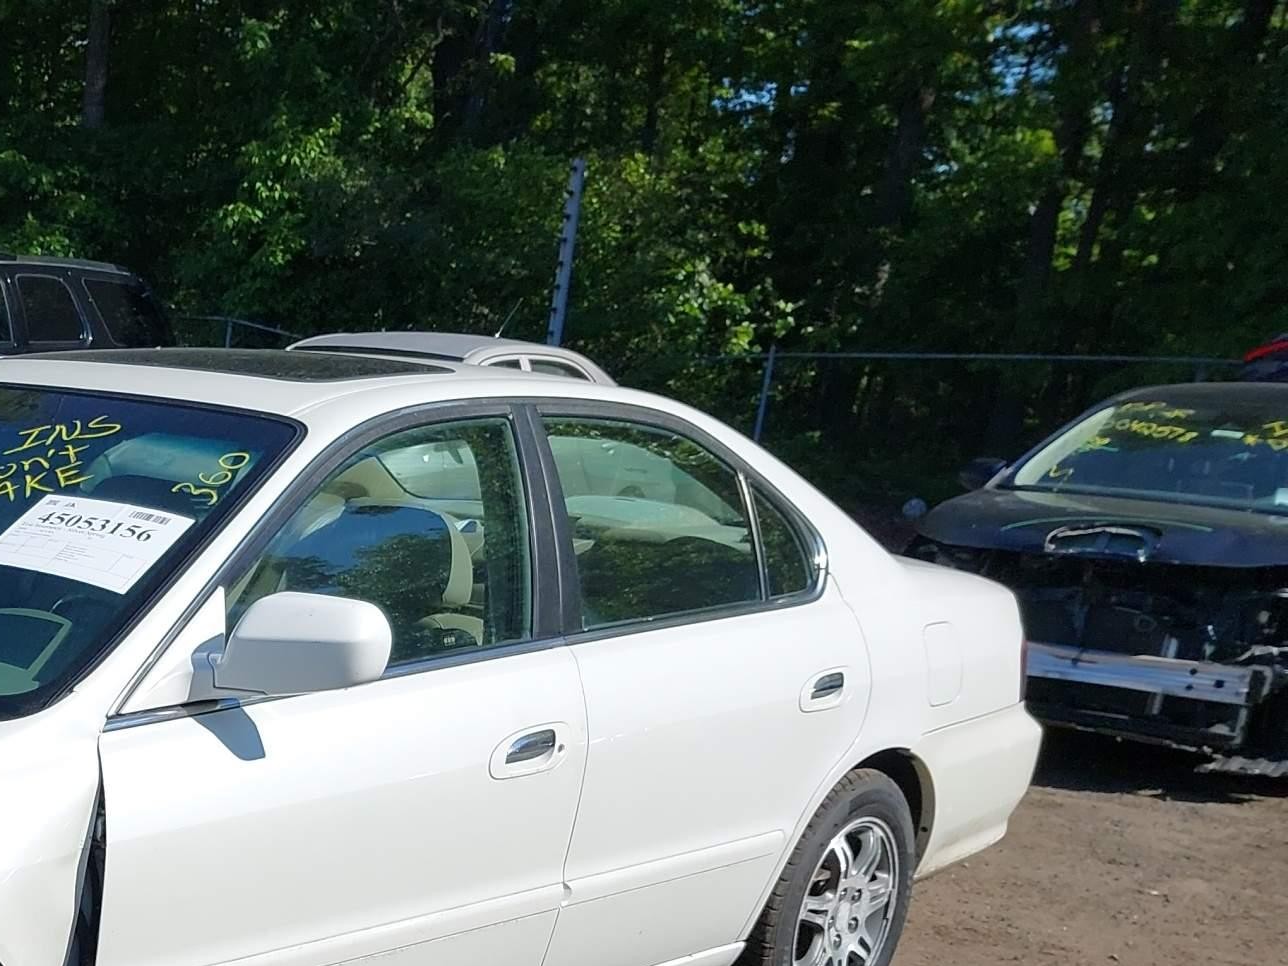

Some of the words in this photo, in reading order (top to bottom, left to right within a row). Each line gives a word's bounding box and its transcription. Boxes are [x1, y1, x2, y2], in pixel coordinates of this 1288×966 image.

[3, 415, 122, 455] INS
[171, 452, 250, 506] 360
[37, 511, 159, 542] 45053156
